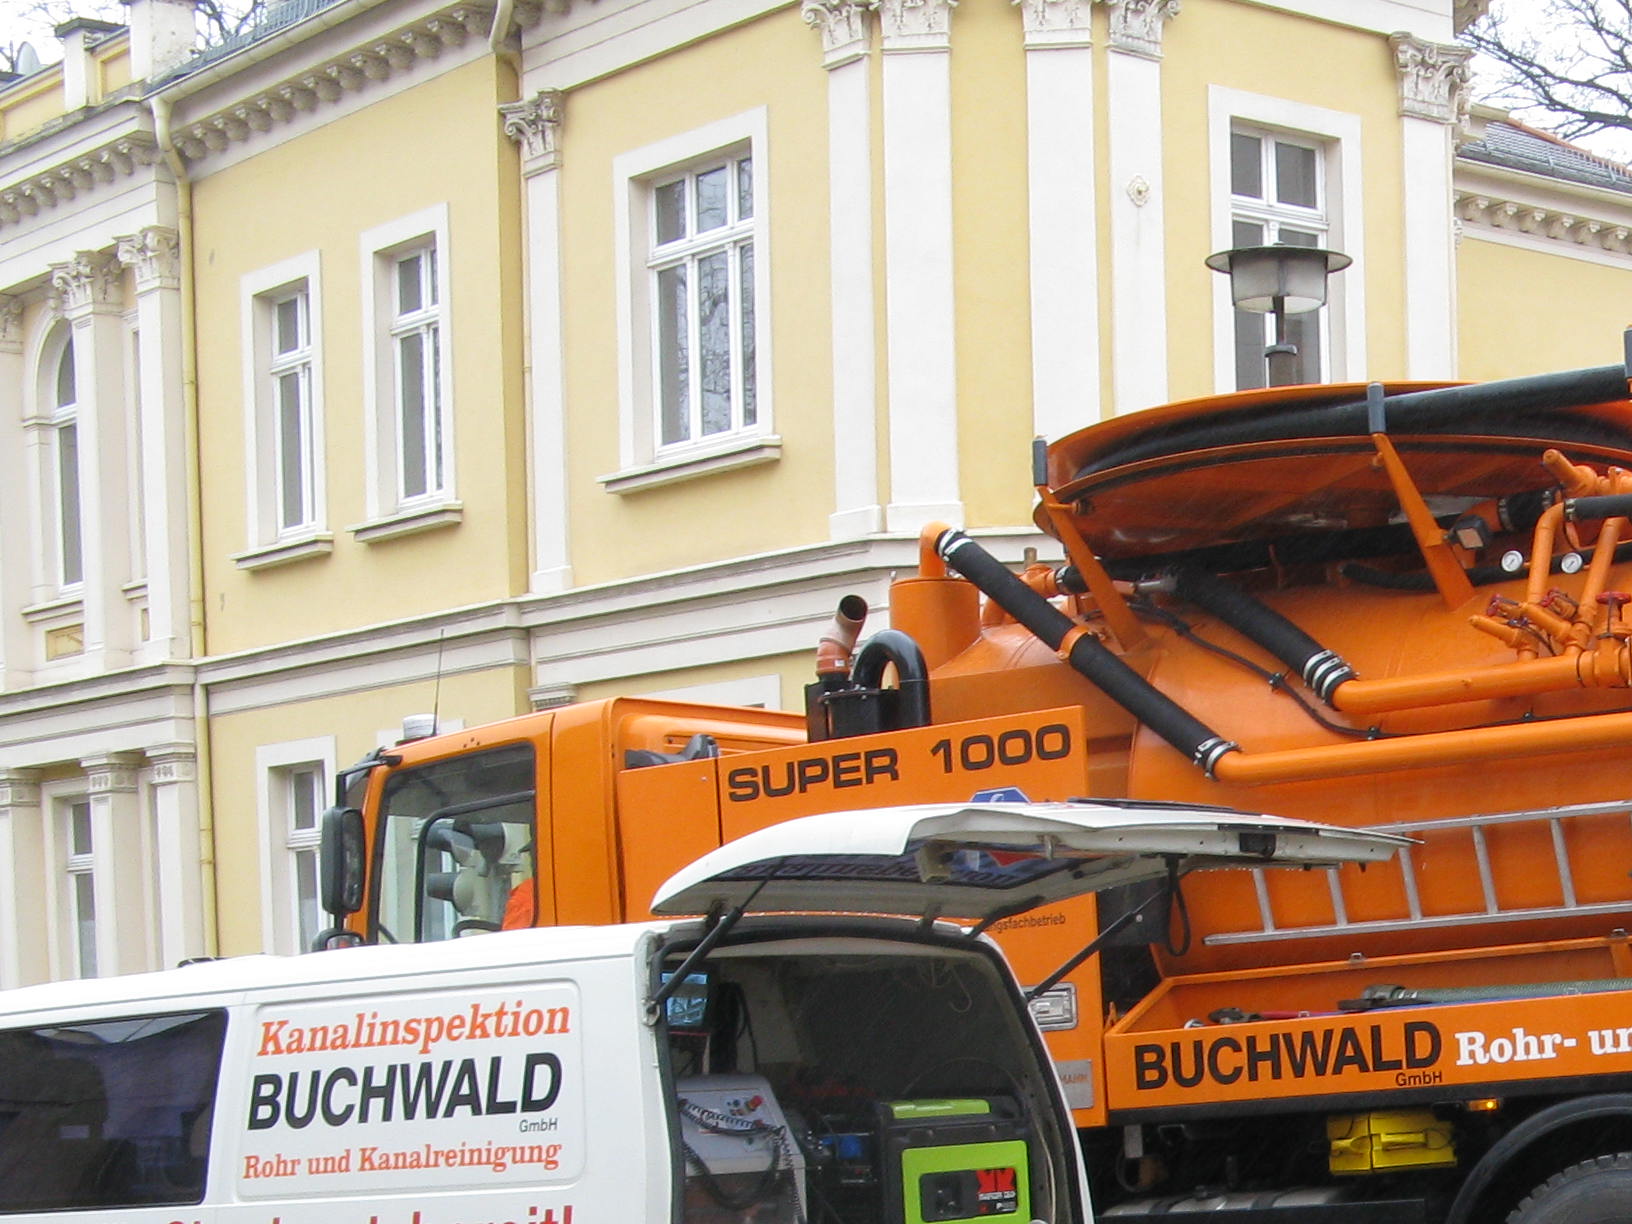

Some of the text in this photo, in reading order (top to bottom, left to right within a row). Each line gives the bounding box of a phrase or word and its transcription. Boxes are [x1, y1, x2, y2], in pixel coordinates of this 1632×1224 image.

[728, 724, 1071, 802] SUPER 1000
[256, 1000, 571, 1057] Kanalinspektion
[1134, 1021, 1442, 1091] BUCHWALD
[1454, 1027, 1577, 1066] Rohr-
[247, 1052, 563, 1130] BUCHWALD
[1395, 1071, 1443, 1087] GmbH
[519, 1117, 559, 1133] GmbH
[242, 1141, 562, 1179] Rohr und Kanalreinigung
